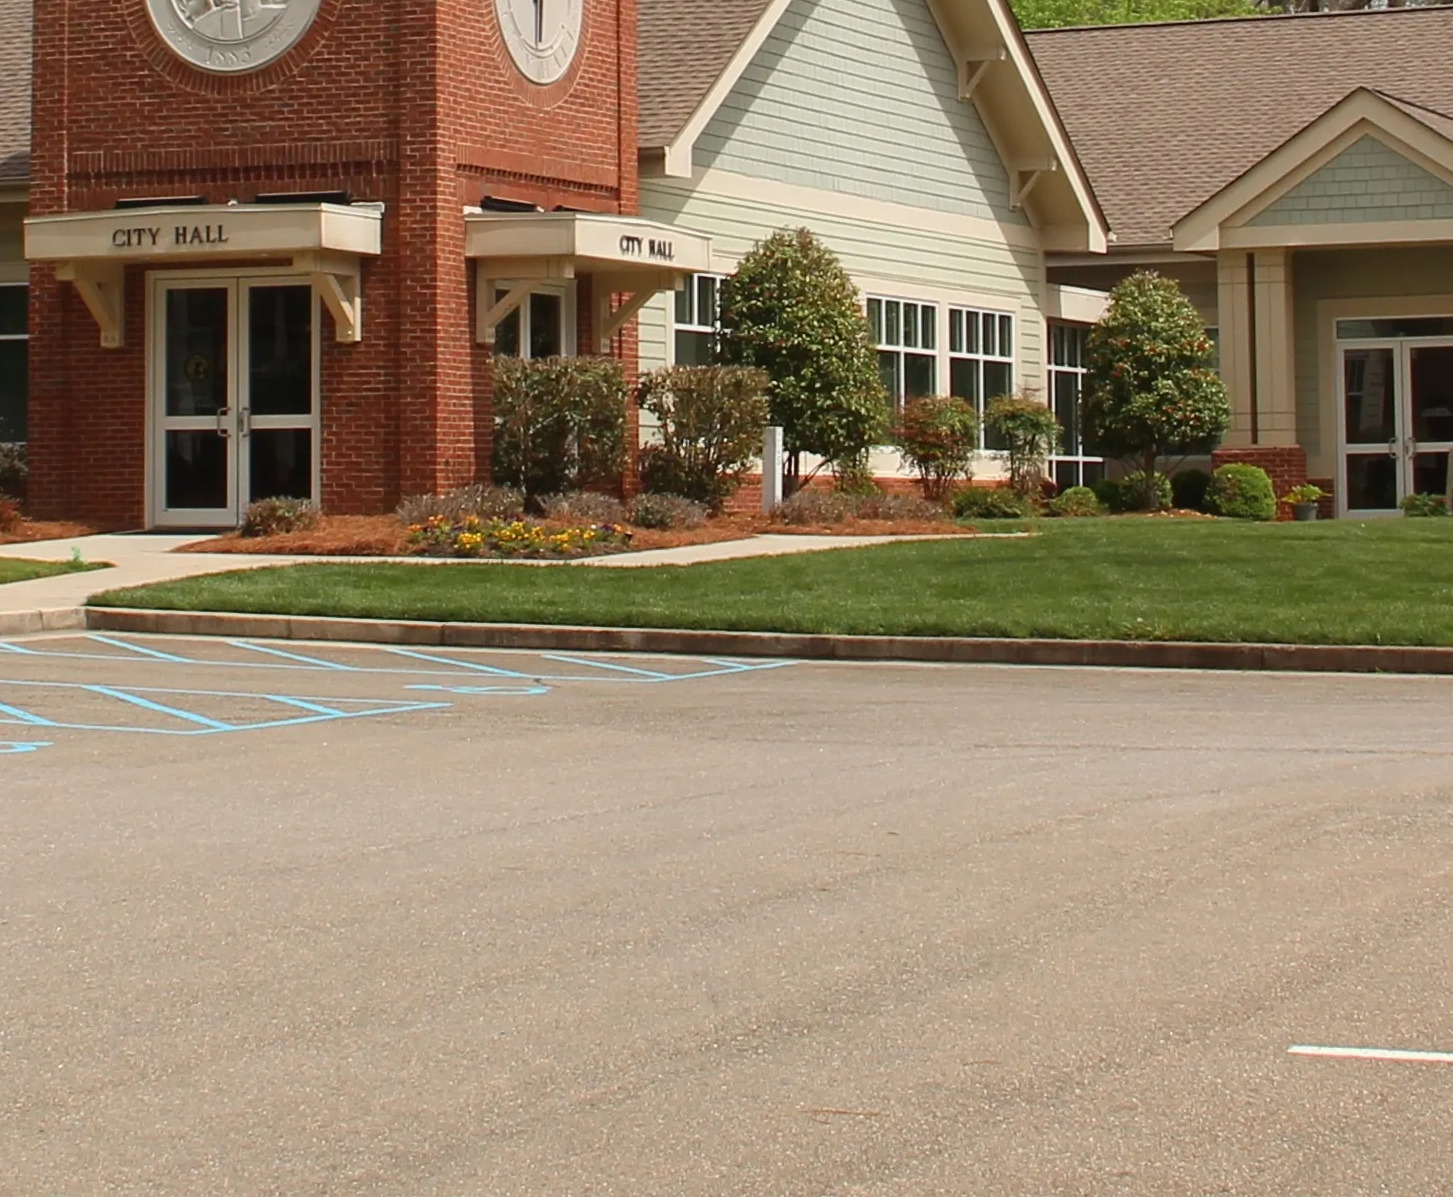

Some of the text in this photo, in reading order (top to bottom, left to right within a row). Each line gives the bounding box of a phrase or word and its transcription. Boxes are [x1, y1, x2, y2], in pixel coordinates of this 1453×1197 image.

[112, 224, 230, 247] CITY HALL
[619, 235, 674, 260] CITY HALL
